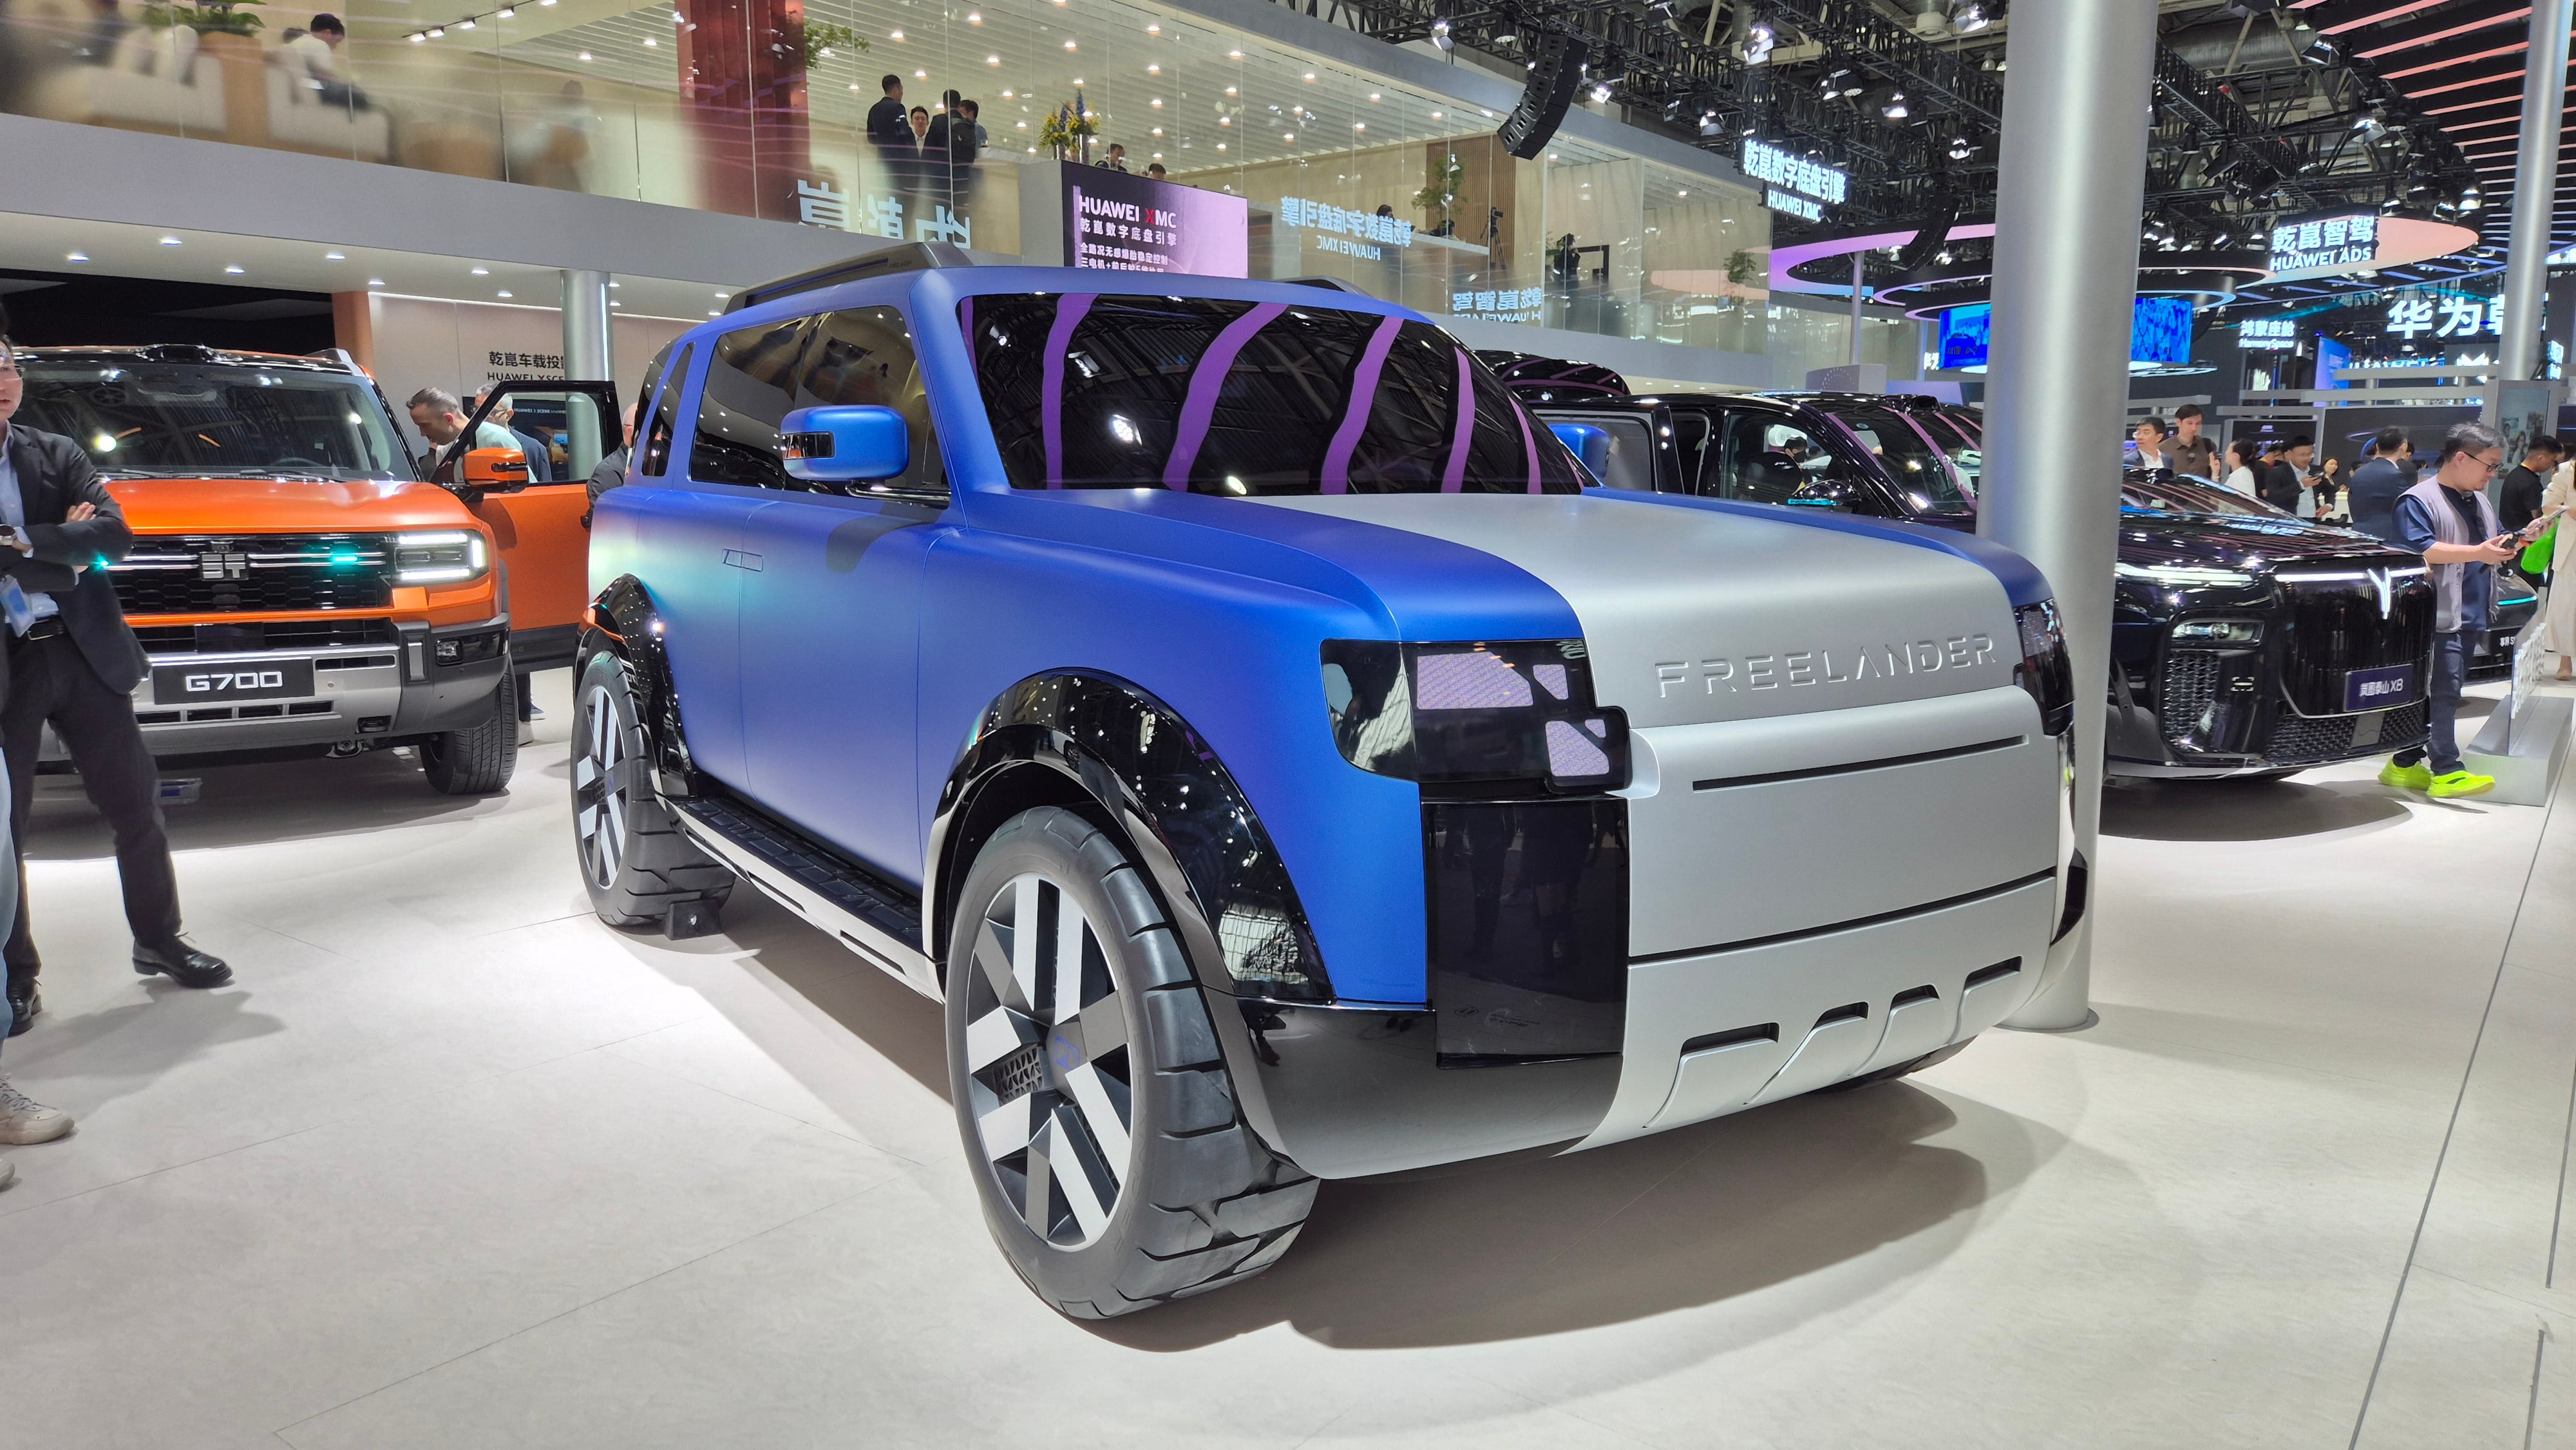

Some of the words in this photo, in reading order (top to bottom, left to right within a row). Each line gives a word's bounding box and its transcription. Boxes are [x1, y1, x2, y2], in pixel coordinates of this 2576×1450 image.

[1743, 139, 1846, 204] 乾崑数字底盘引擎
[1079, 195, 1139, 222] HUAWEI
[1145, 208, 1177, 228] XMC
[1768, 190, 1802, 216] HUAWEI
[1803, 200, 1822, 222] XMC
[1080, 217, 1177, 247] 乾崑数字底盘引擎
[2271, 216, 2374, 253] 乾崑智驾
[2270, 250, 2336, 271] HUAWEI
[2338, 246, 2371, 263] ADS
[489, 351, 564, 369] 乾崑车载投
[487, 372, 533, 381] HUAWEI
[1654, 633, 1996, 698] FREELANDER
[185, 671, 283, 692] G700
[2390, 678, 2403, 692] X8
